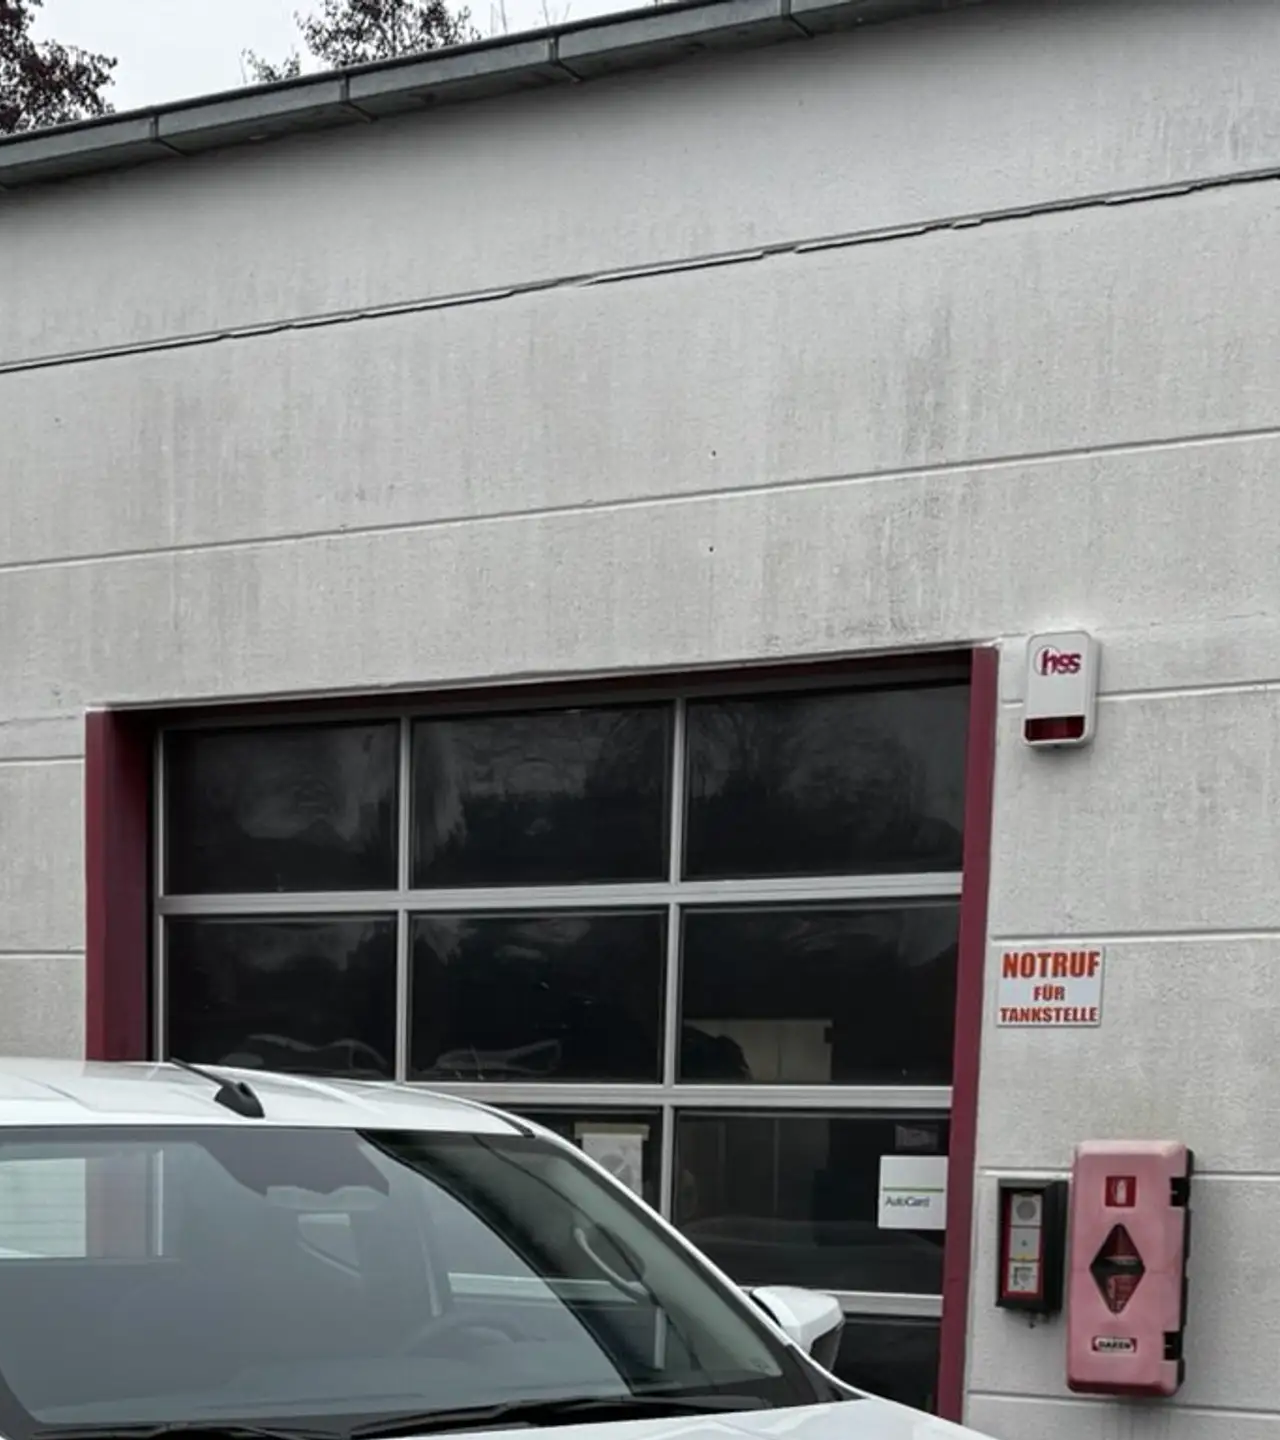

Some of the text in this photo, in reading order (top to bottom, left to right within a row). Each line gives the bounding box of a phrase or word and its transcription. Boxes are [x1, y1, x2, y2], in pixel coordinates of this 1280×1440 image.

[1041, 649, 1081, 676] hss
[1002, 951, 1101, 979] NOTRUF
[1033, 984, 1065, 1001] FÜR
[999, 1006, 1098, 1023] TANKSTELLE
